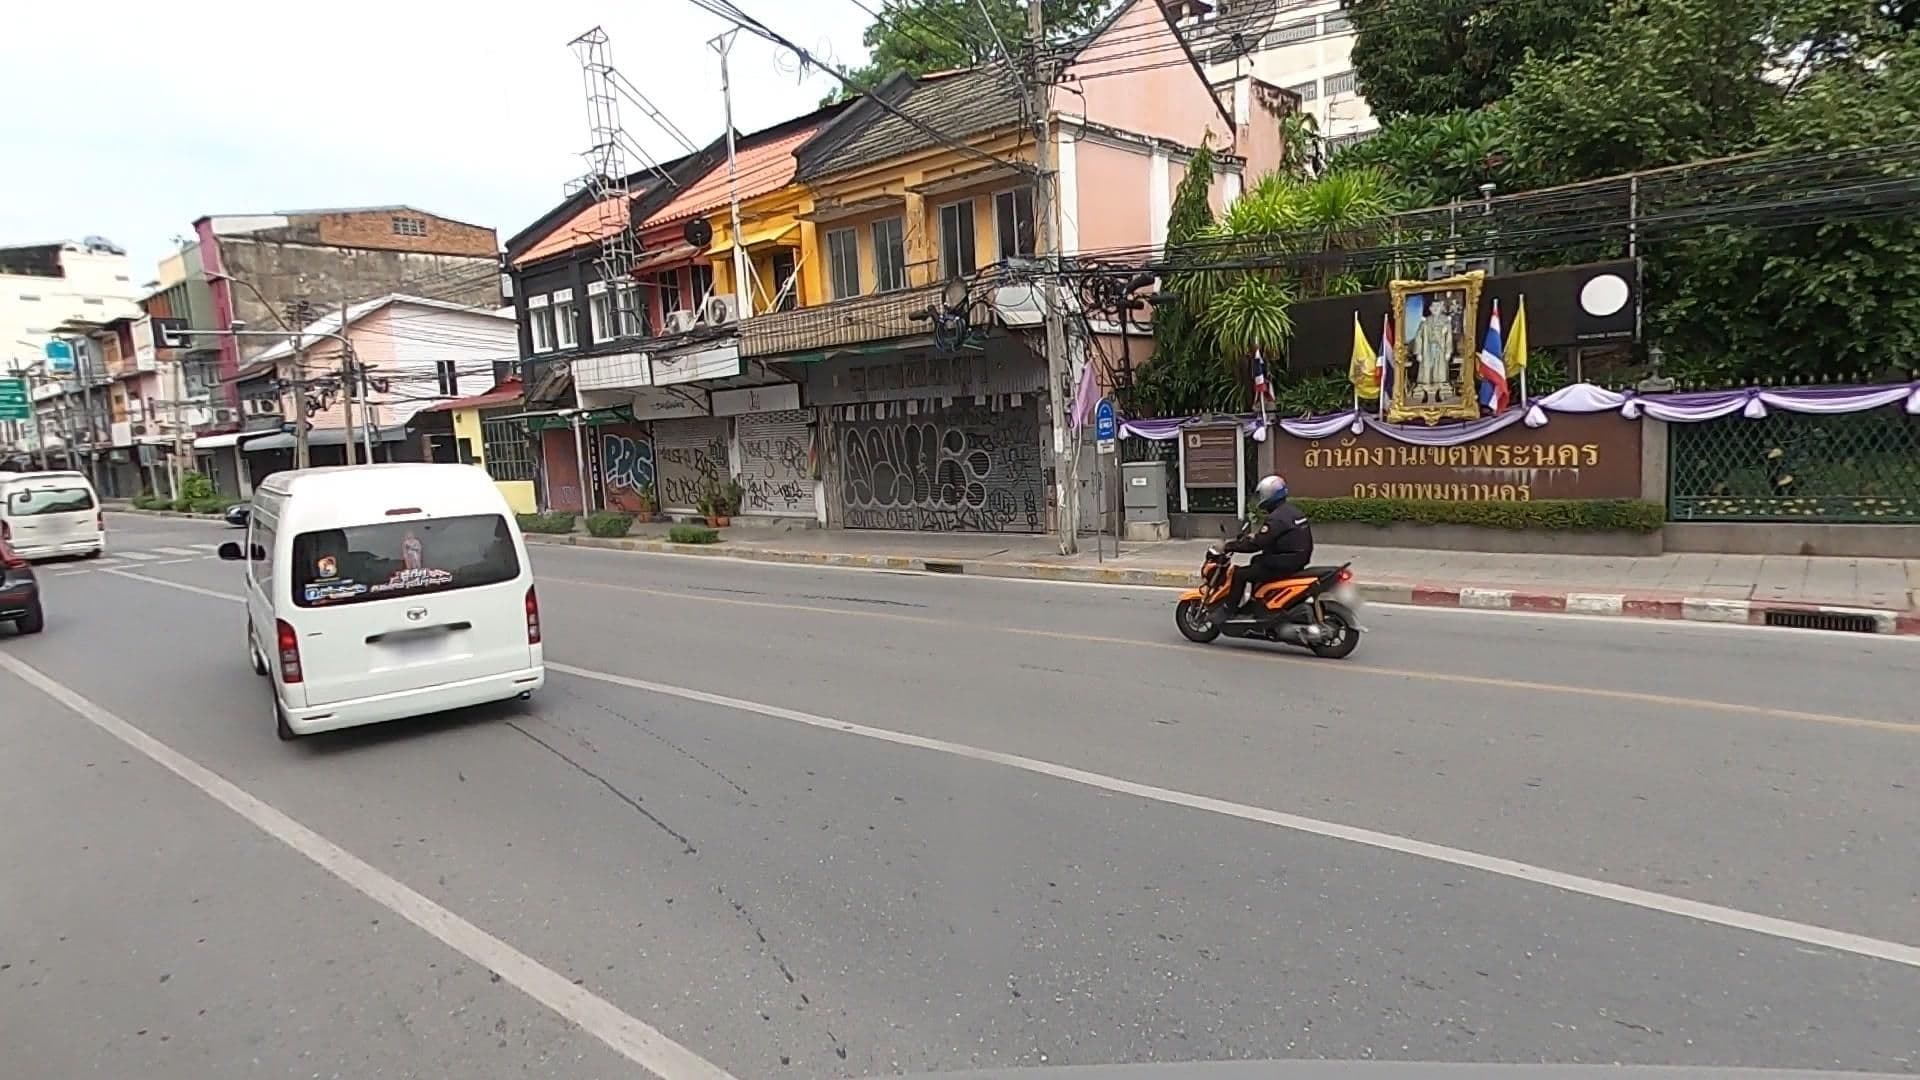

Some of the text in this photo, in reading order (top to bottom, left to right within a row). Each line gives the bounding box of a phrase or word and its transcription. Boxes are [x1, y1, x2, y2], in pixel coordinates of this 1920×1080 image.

[1304, 437, 1599, 468] สำนักงานเขตพระนคร
[1353, 482, 1531, 501] กรงเทพมหานคร
